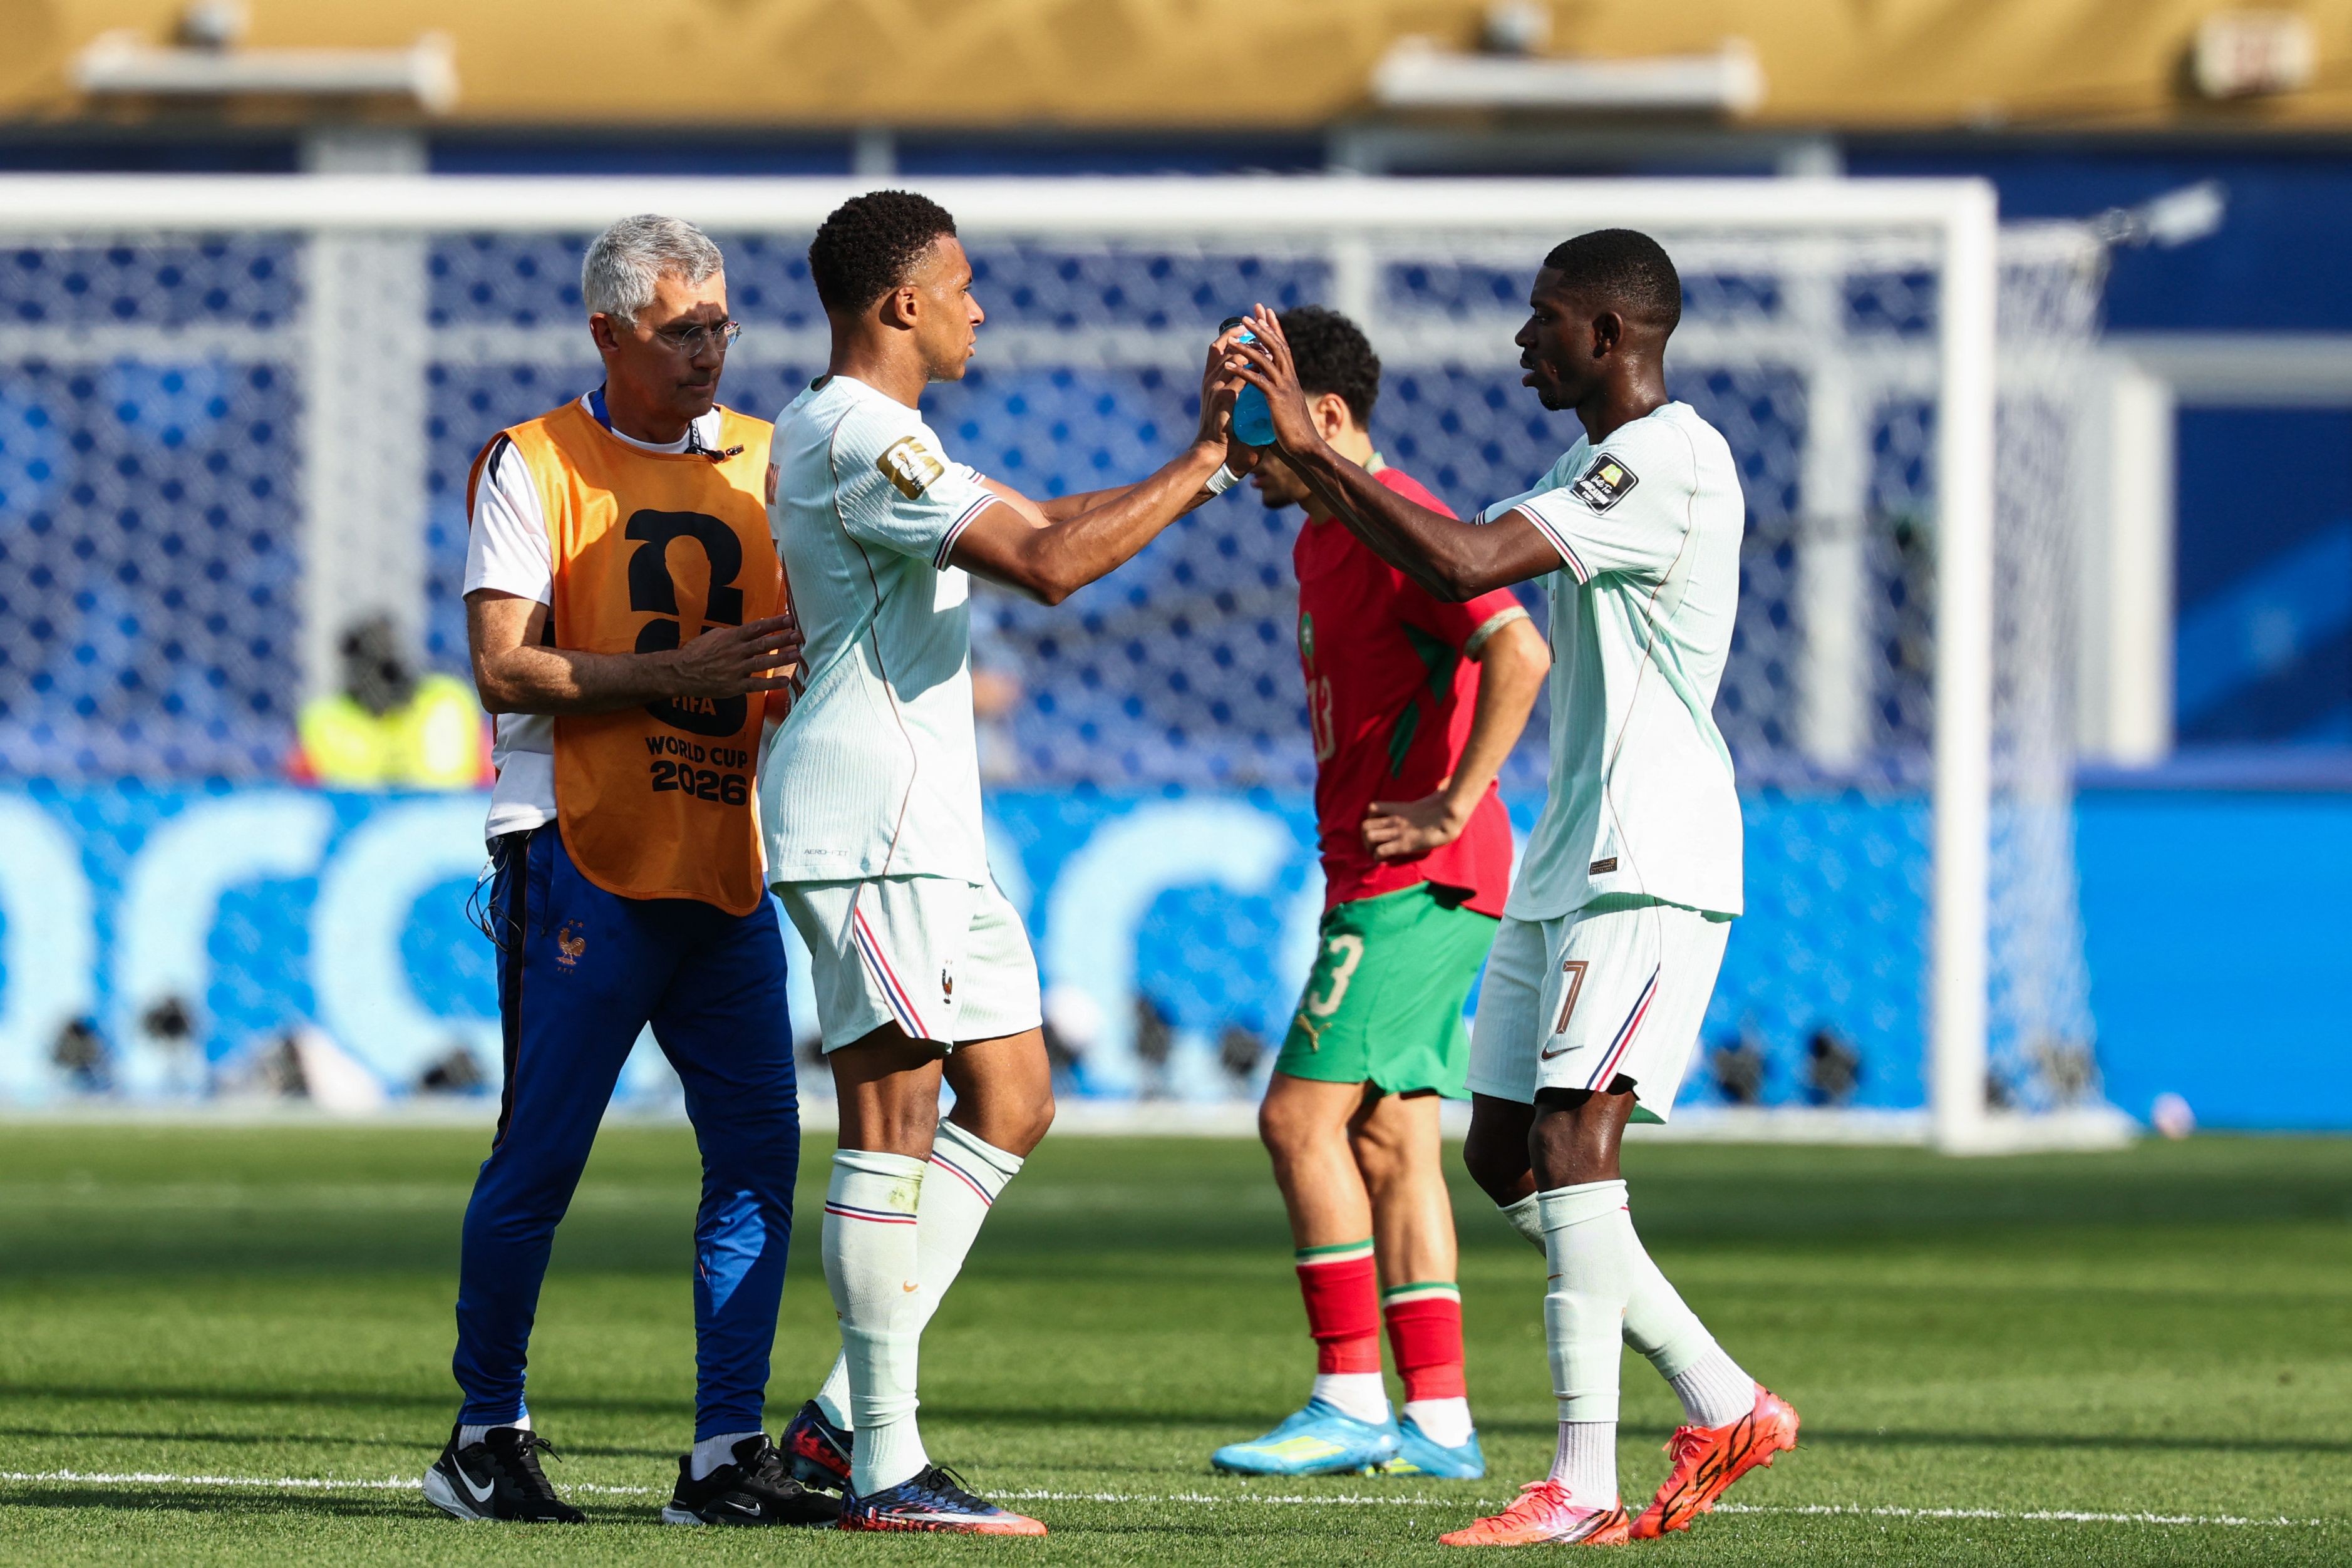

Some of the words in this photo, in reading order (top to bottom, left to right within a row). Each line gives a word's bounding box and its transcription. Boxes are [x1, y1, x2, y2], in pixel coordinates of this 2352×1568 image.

[692, 418, 700, 445] 202
[671, 696, 716, 716] FIFA
[645, 736, 706, 763] WORLD
[710, 747, 748, 769] CUP
[649, 760, 747, 807] 2026
[1555, 961, 1589, 1034] 7
